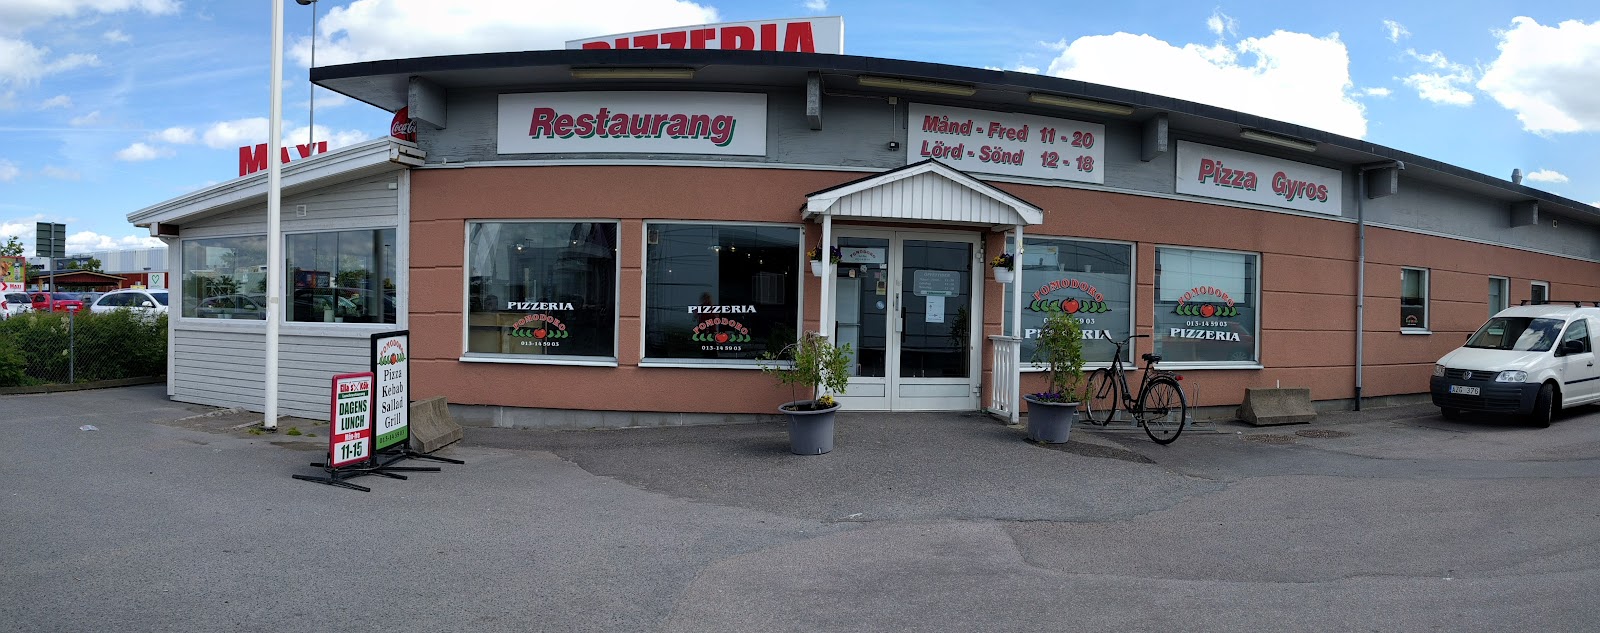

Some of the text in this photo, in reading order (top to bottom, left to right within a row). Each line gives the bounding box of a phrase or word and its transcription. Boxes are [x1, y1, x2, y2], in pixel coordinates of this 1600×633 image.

[528, 107, 736, 147] Restaurang
[922, 115, 973, 136] Månd
[987, 121, 1029, 142] Fred
[1039, 127, 1056, 144] 11
[1071, 130, 1094, 149] 20
[920, 140, 964, 160] Lörd
[978, 145, 1024, 166] Sönd
[1040, 151, 1059, 168] 12
[1075, 155, 1094, 172] 18
[1198, 158, 1329, 203] Pizza Gyros
[1032, 278, 1104, 302] POMODORO
[1177, 286, 1235, 307] POMODORO
[507, 301, 574, 311] PIZZERIA
[687, 305, 757, 314] PIZZERIA
[513, 314, 566, 331] POMODORO
[693, 317, 748, 335] POMODORO
[1170, 327, 1241, 342] PIZZERIA
[383, 369, 402, 381] Pizza
[382, 385, 403, 397] Kebab
[339, 400, 367, 416] DAGENS
[382, 400, 403, 413] Sallad
[341, 415, 365, 430] LUNCH
[384, 416, 401, 429] Grill
[341, 441, 362, 460] 11-15
